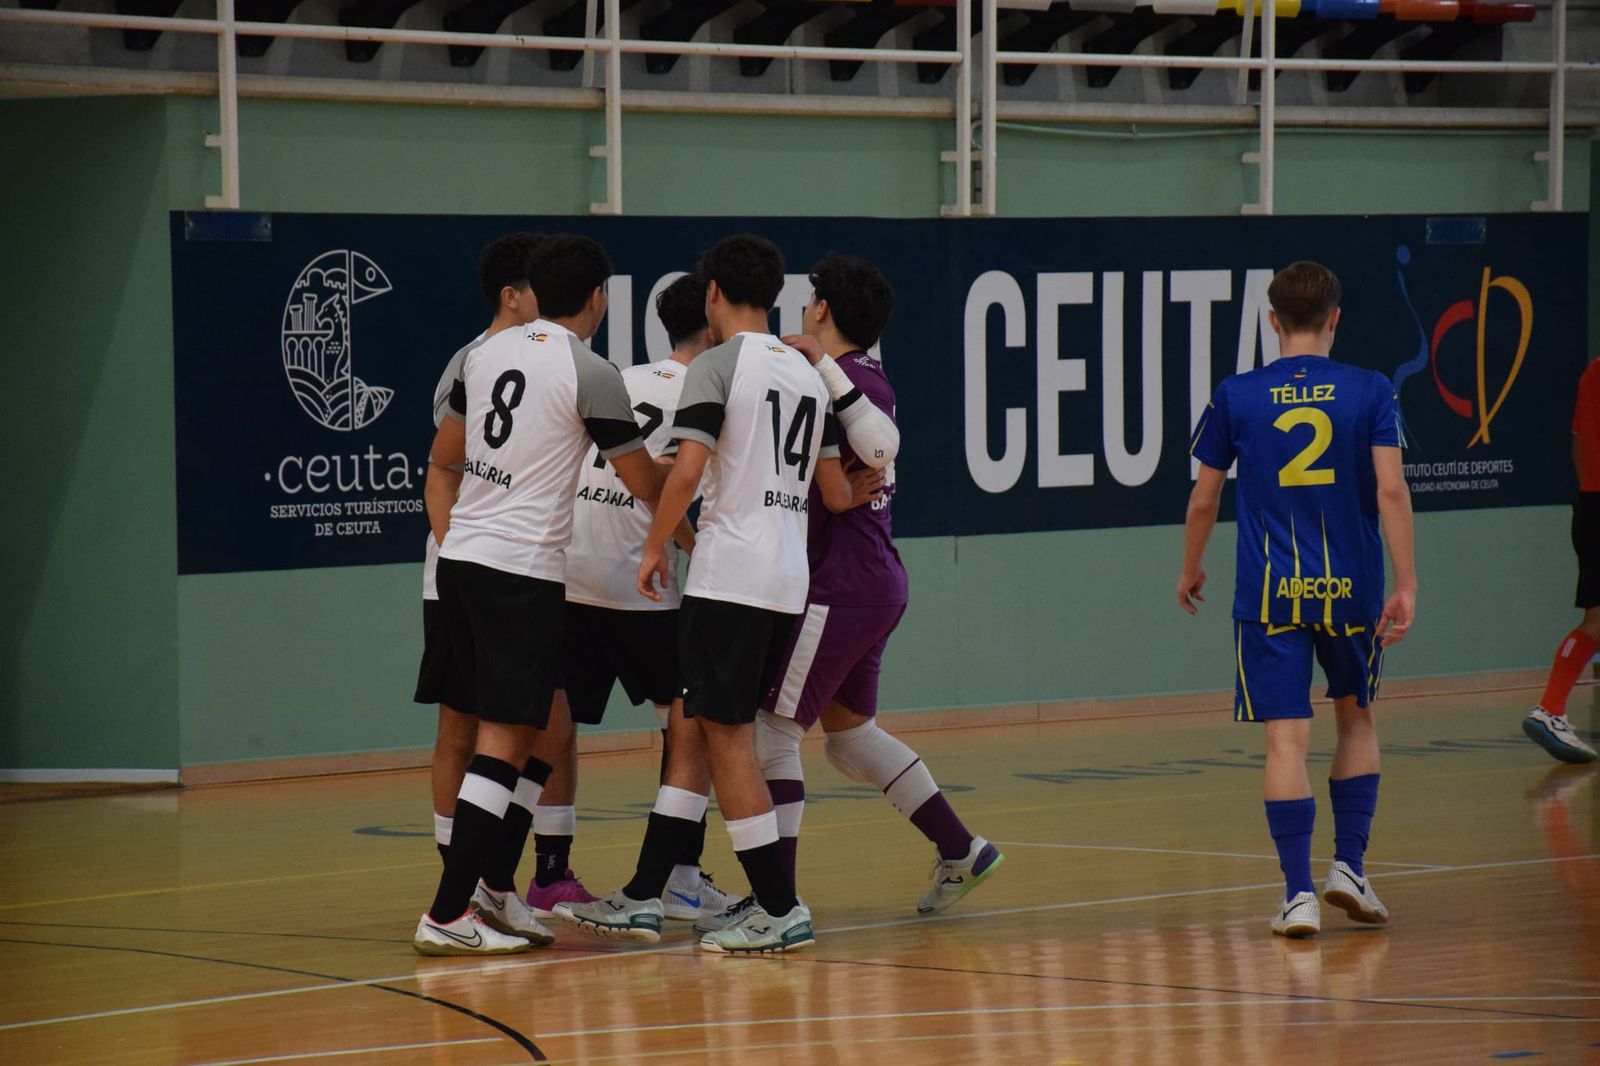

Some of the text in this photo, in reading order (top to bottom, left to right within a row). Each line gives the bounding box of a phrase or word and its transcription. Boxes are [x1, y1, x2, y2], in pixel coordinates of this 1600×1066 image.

[1269, 383, 1335, 405] TÉLLEZ
[483, 369, 526, 449] 8
[765, 388, 817, 482] 14
[1272, 407, 1335, 488] 2
[1402, 463, 1431, 477] TITUTO
[1458, 462, 1469, 475] DE
[1471, 459, 1514, 474] DEPORTES
[270, 499, 423, 519] SERVICIOS TURÍSTICOS
[314, 520, 381, 536] DE CEUTA
[1276, 576, 1353, 600] ADECOR
